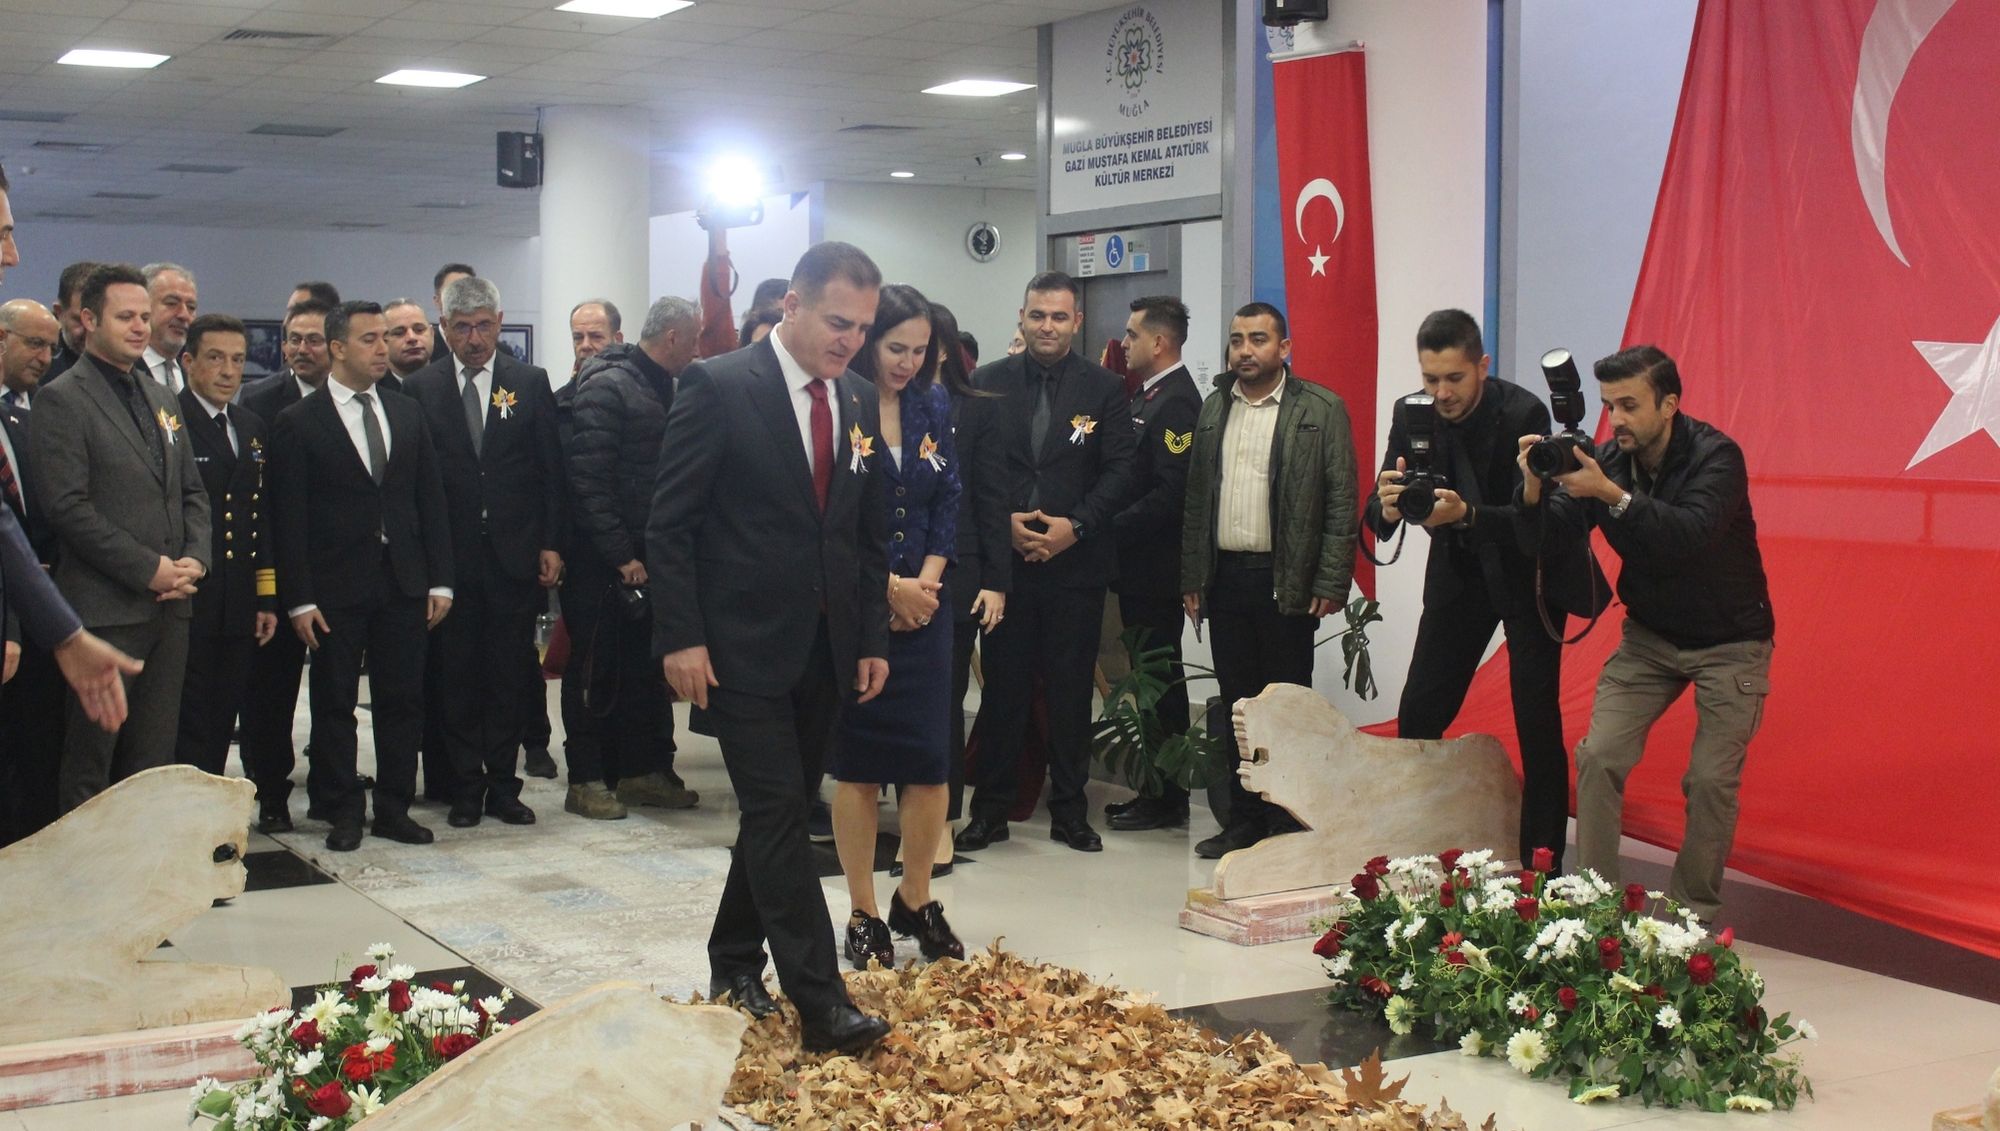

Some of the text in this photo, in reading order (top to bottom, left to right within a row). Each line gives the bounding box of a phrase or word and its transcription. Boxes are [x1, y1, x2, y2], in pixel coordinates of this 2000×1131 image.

[1119, 99, 1150, 117] MUĞLA
[1095, 128, 1154, 149] BÜYÜKŞEHİR
[1157, 116, 1213, 140] BELEDİYESİ
[1065, 139, 1209, 172] GAZİ MUSTAFA KEMAL ATATÜRK
[1095, 162, 1174, 187] KÜLTÜR MERKEZİ
